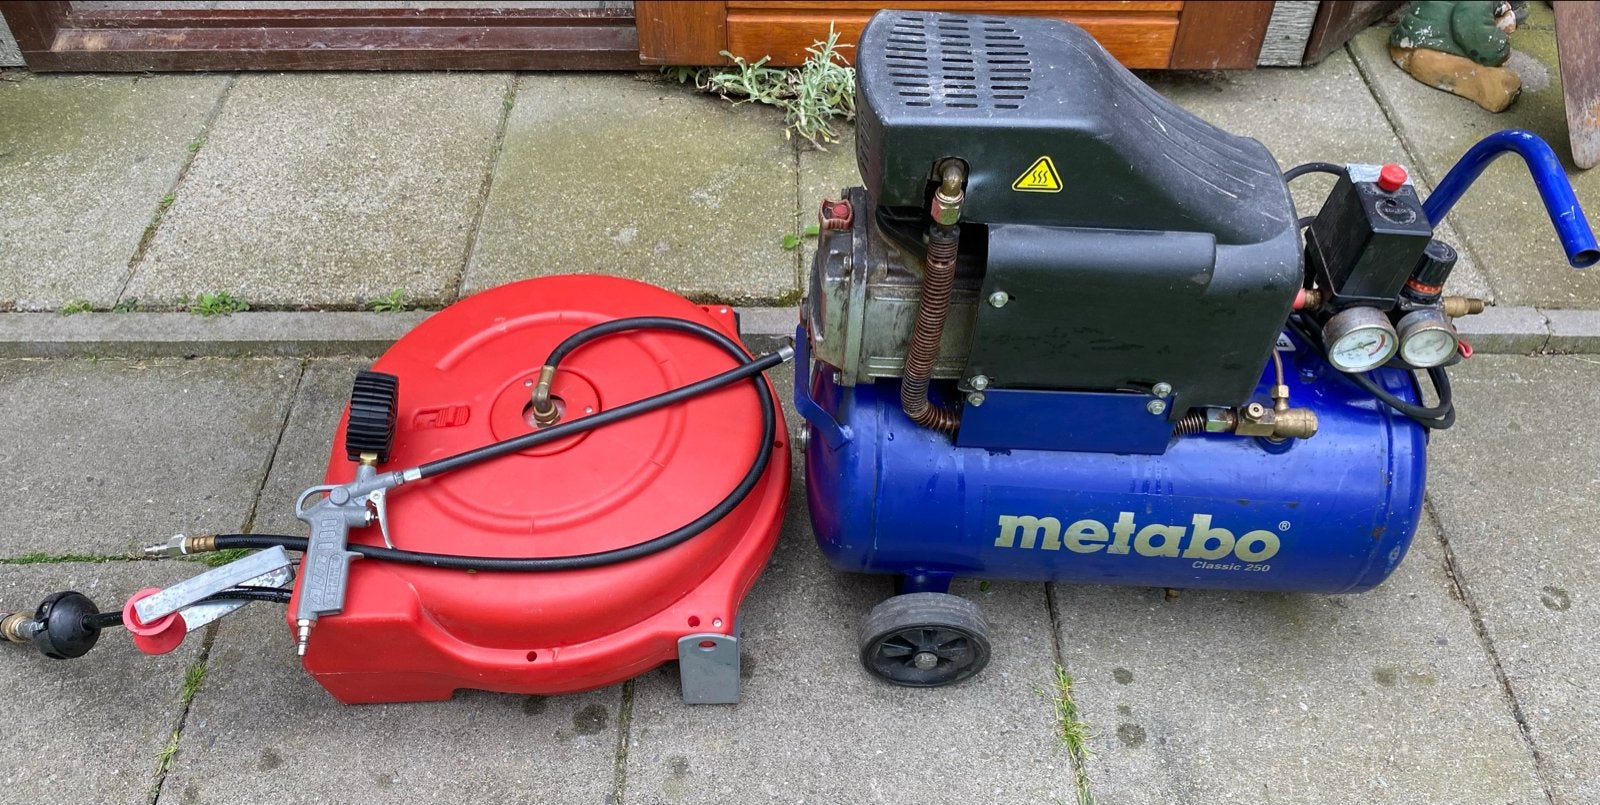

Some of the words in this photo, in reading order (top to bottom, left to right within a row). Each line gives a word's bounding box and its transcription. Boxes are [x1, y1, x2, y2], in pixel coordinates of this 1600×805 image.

[994, 511, 1281, 562] metabo
[1192, 560, 1241, 571] Classic
[1244, 563, 1271, 572] 250
